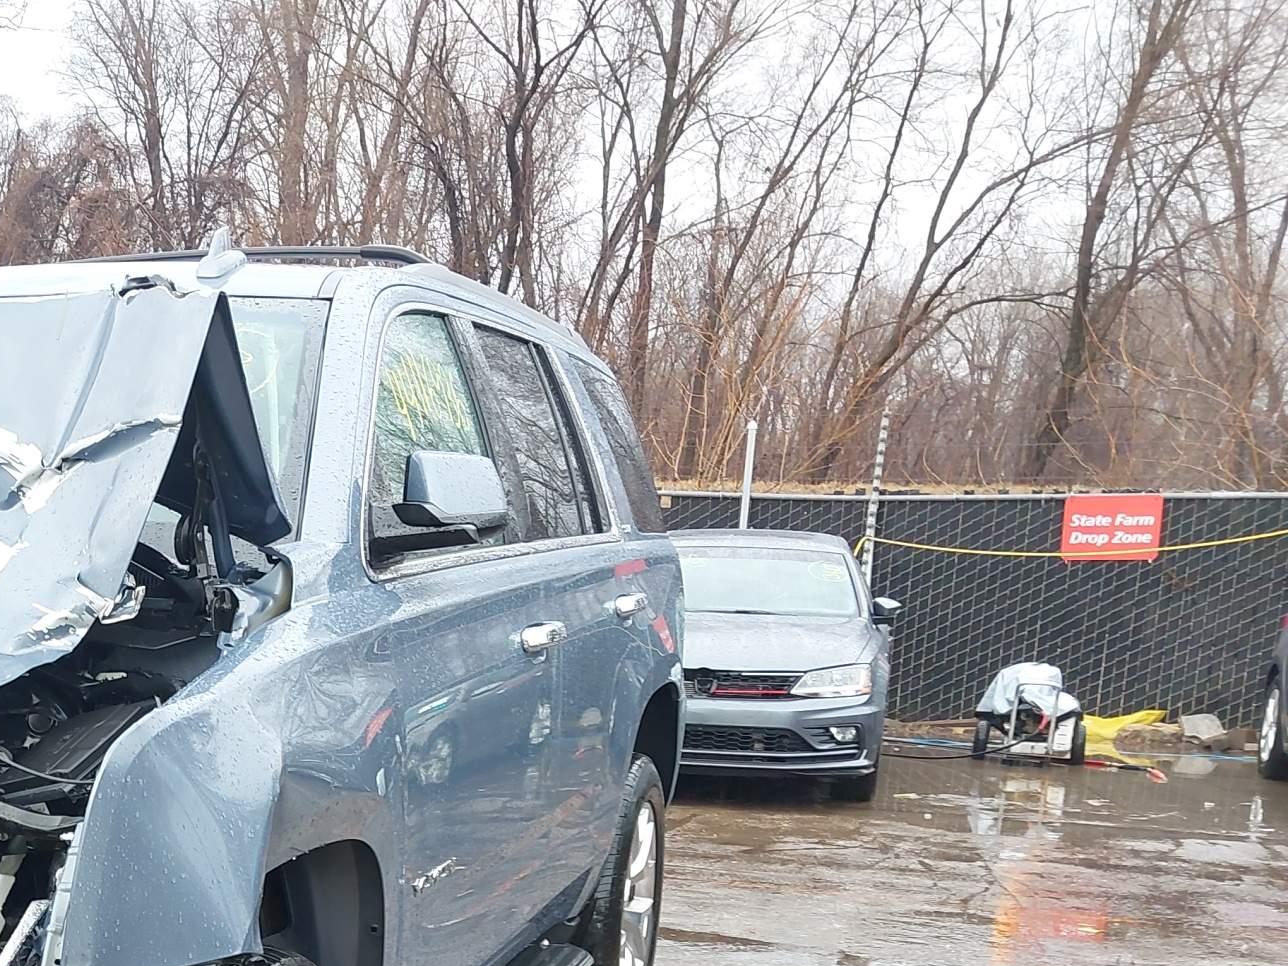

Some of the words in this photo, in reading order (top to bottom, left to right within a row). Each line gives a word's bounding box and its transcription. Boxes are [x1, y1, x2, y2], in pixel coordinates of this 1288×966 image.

[1069, 514, 1112, 527] State
[1114, 513, 1155, 526] Farm
[1069, 531, 1109, 546] Drop
[1111, 531, 1153, 544] Zone
